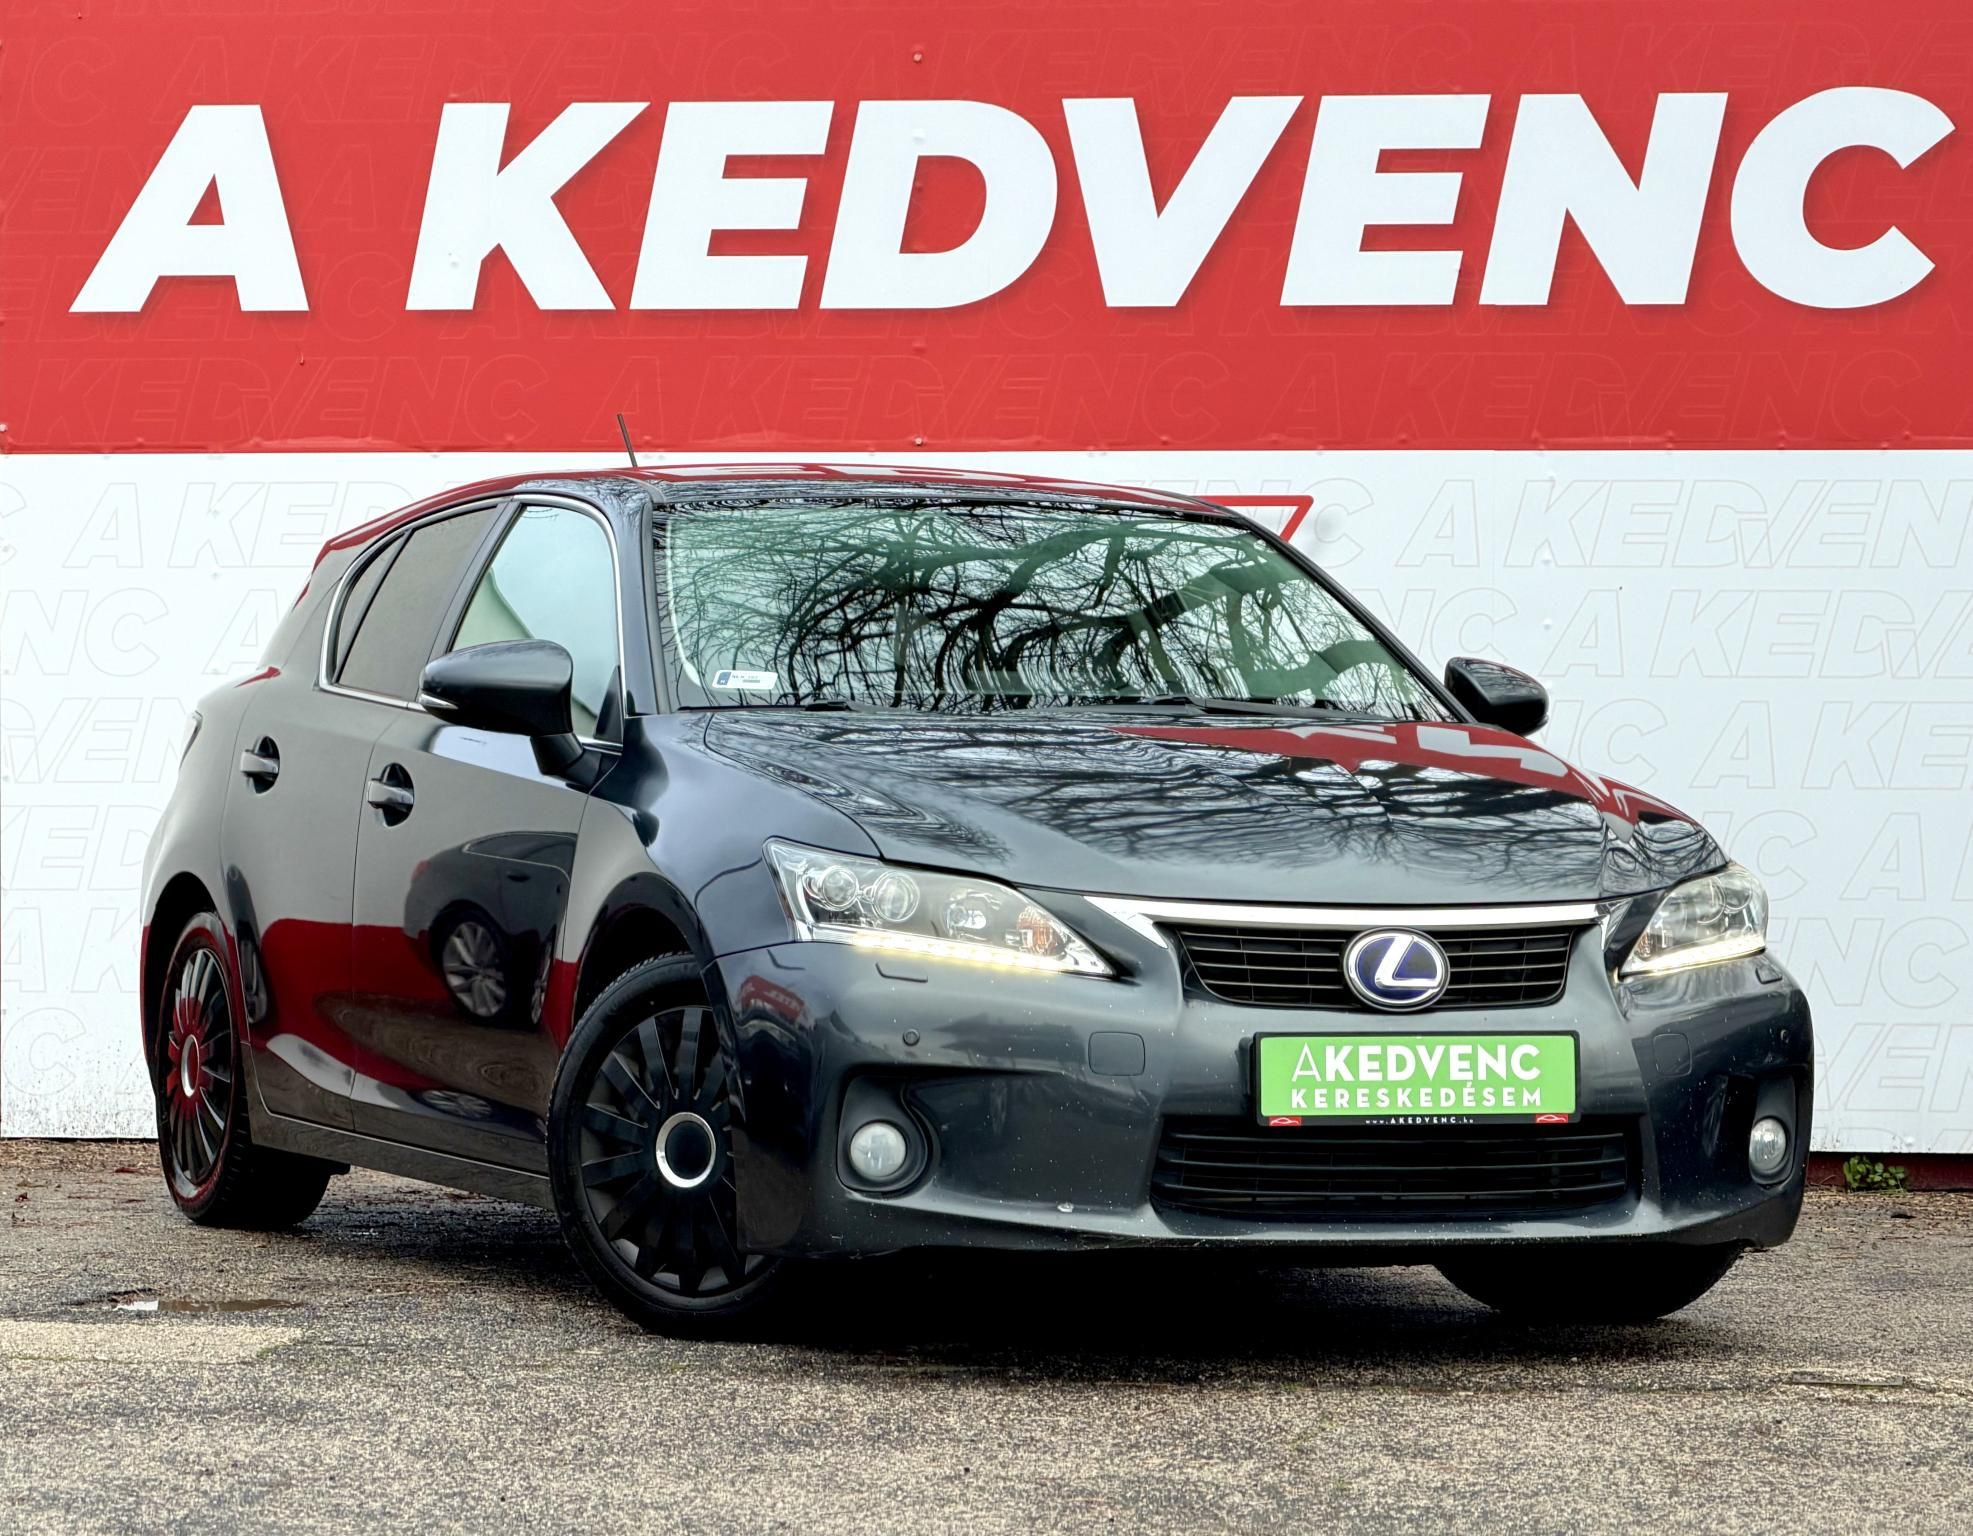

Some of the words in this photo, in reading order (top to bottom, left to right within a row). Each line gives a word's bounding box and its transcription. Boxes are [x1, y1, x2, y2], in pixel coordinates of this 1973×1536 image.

[70, 103, 310, 313] A
[404, 85, 1957, 312] KEDVENC
[1291, 1082, 1542, 1109] KERESKEDÉSEM
